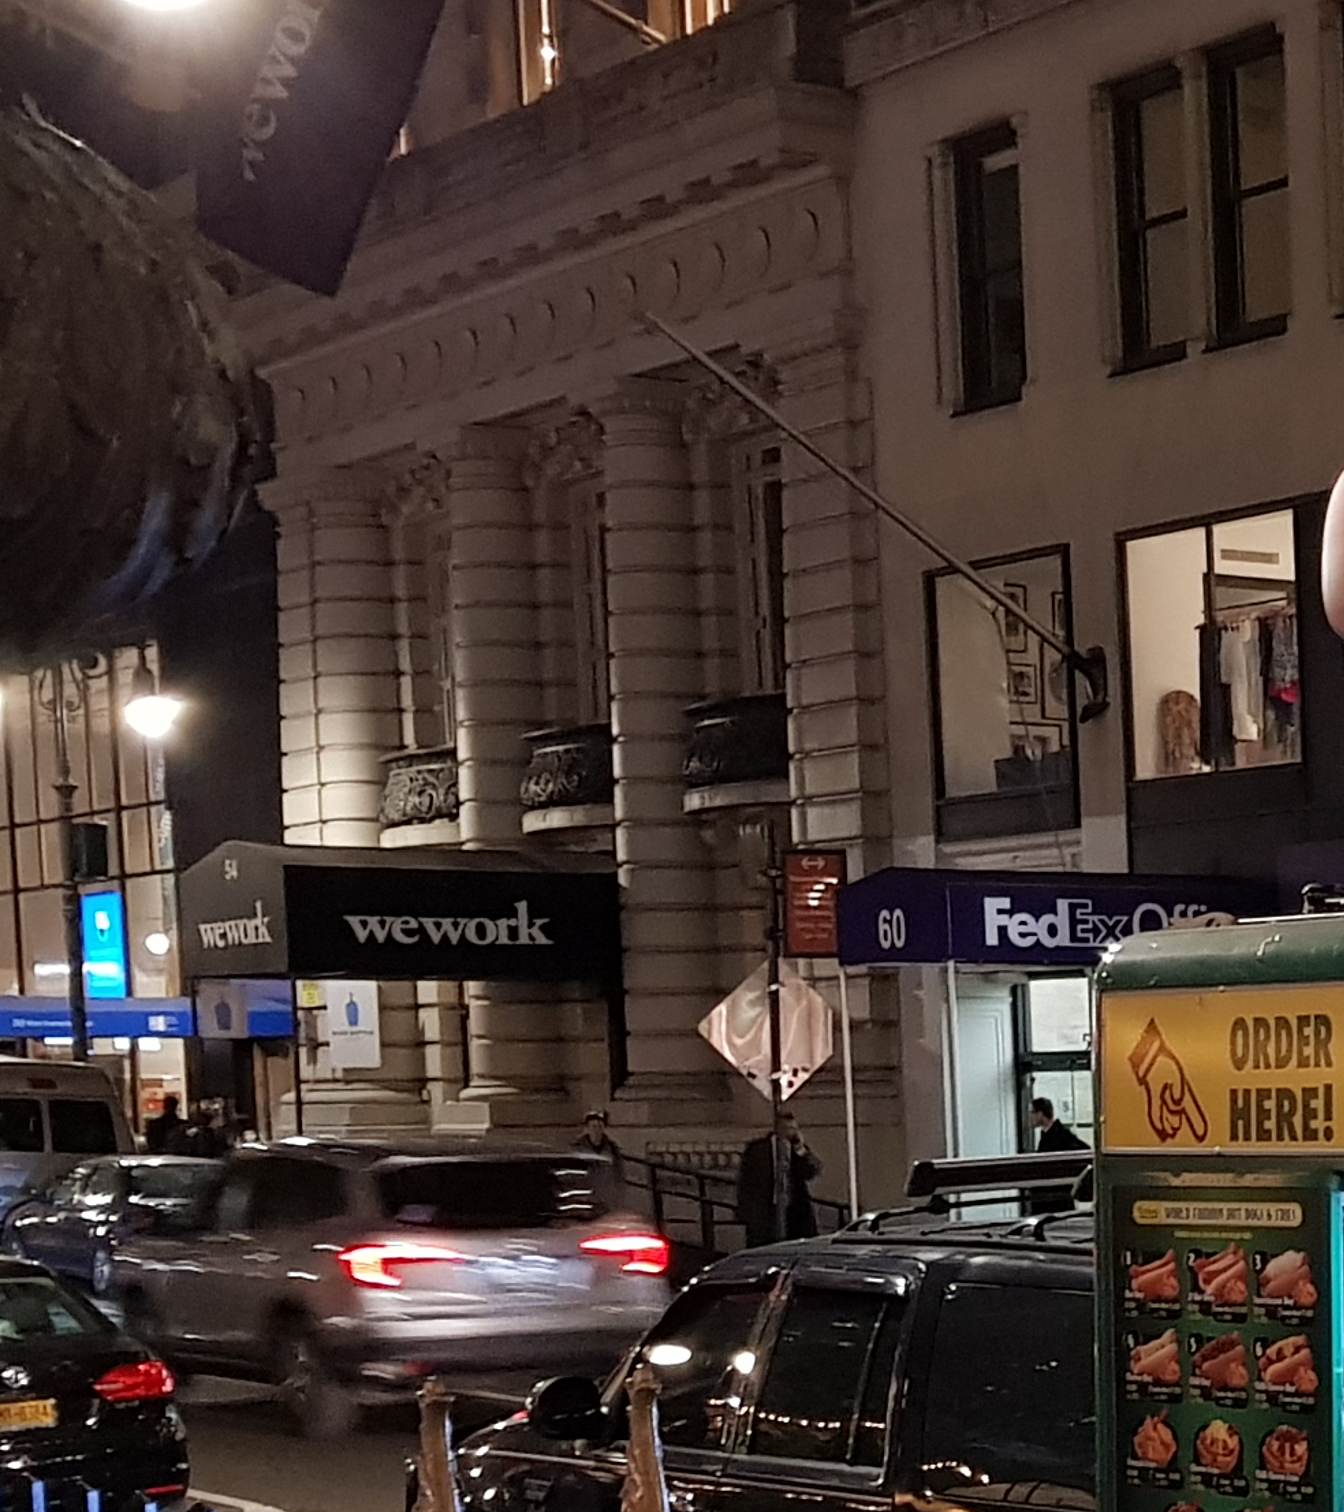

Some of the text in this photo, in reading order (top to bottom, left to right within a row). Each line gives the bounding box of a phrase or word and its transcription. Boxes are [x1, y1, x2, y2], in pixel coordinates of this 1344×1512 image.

[224, 859, 237, 880] 54
[198, 900, 272, 949] wework
[343, 900, 554, 946] wework
[877, 907, 906, 949] 60
[983, 896, 1128, 948] FedEx
[1229, 1014, 1334, 1072] ORDER
[1229, 1086, 1336, 1143] HERE!
